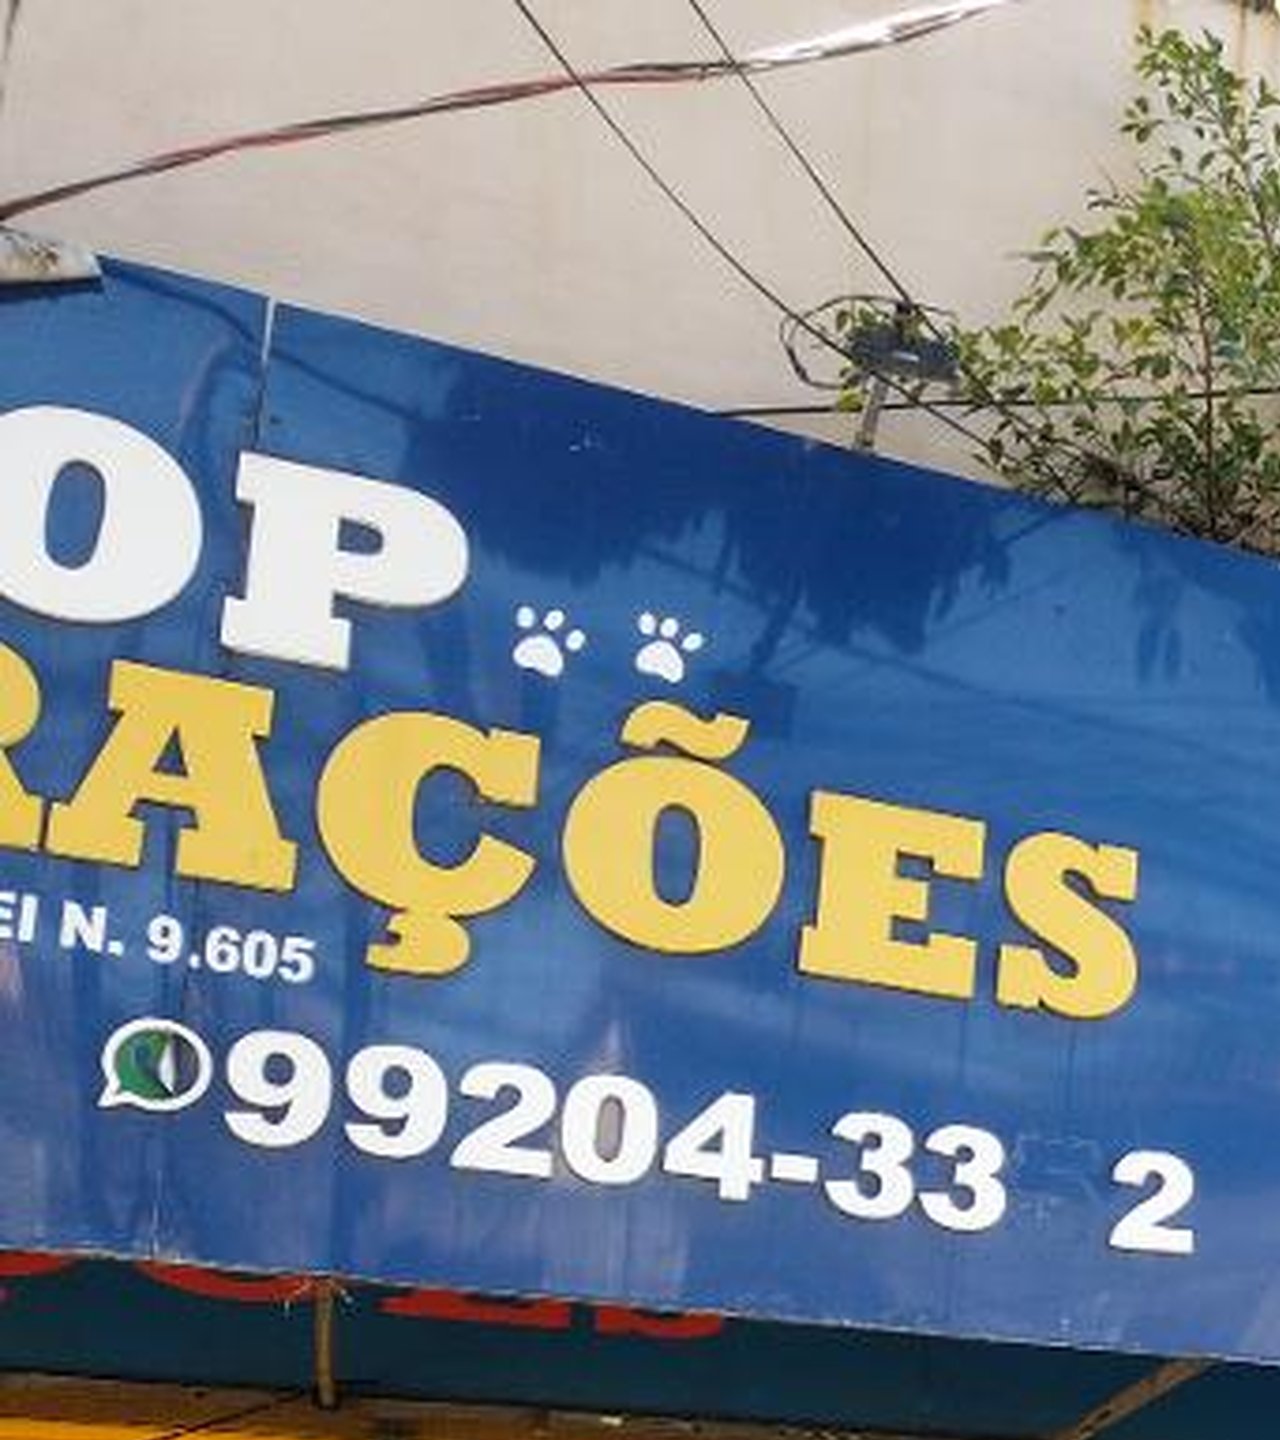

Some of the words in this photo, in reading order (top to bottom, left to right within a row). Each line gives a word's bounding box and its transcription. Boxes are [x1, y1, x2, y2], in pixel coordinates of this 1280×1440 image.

[0, 405, 470, 670] OP
[0, 641, 1139, 1020] AÇÕES
[59, 900, 125, 956] N.
[146, 914, 317, 984] 9.605
